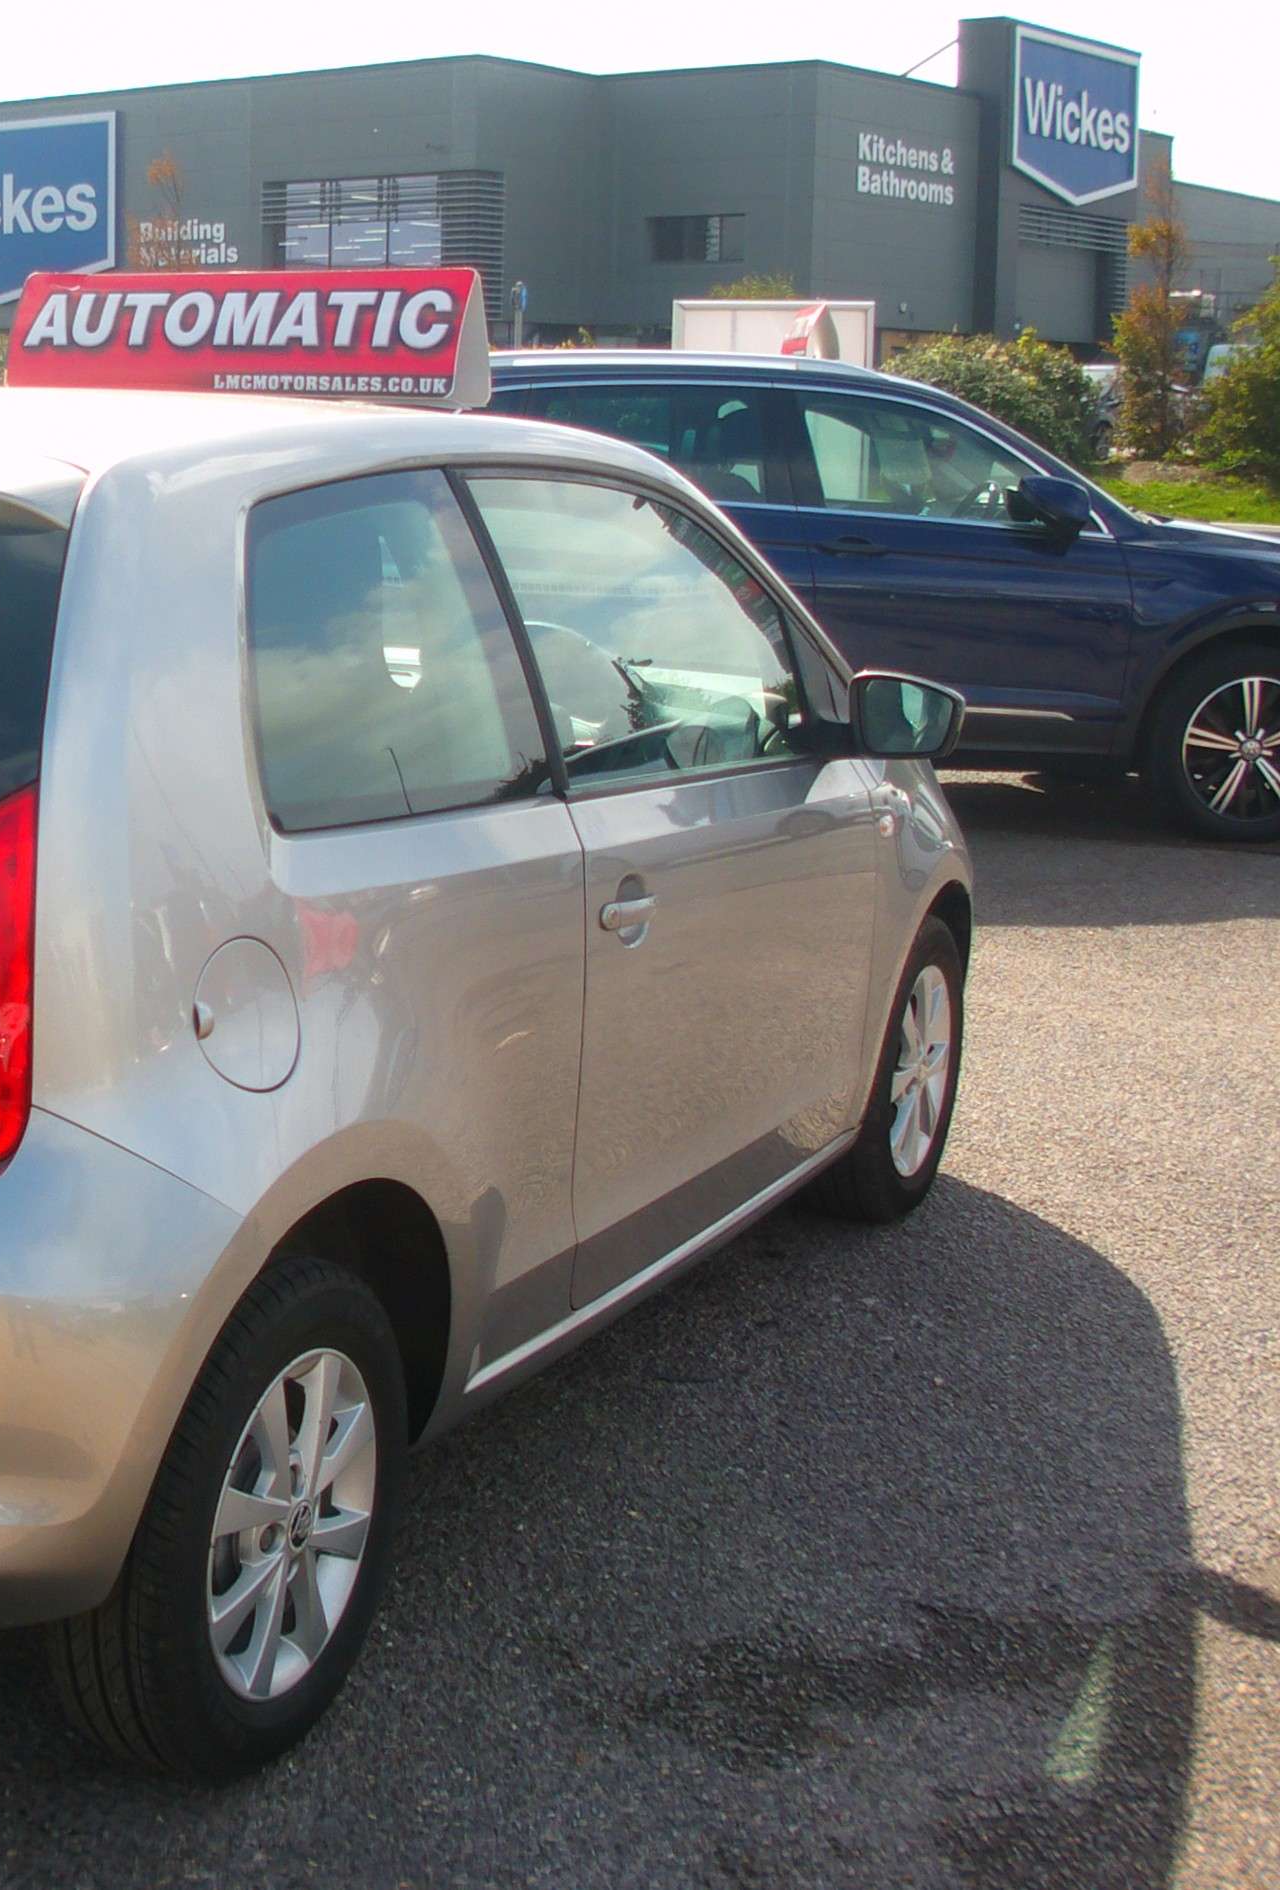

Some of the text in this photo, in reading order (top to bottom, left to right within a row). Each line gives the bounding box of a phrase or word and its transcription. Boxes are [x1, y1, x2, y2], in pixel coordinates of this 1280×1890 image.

[1024, 76, 1129, 154] Wickes
[858, 132, 954, 175] Kitchens &
[858, 165, 954, 205] Bathrooms
[140, 219, 224, 243] Building
[23, 289, 452, 349] AUTOMATIC
[213, 374, 447, 394] LMCMOTORSALES.CO.UK
